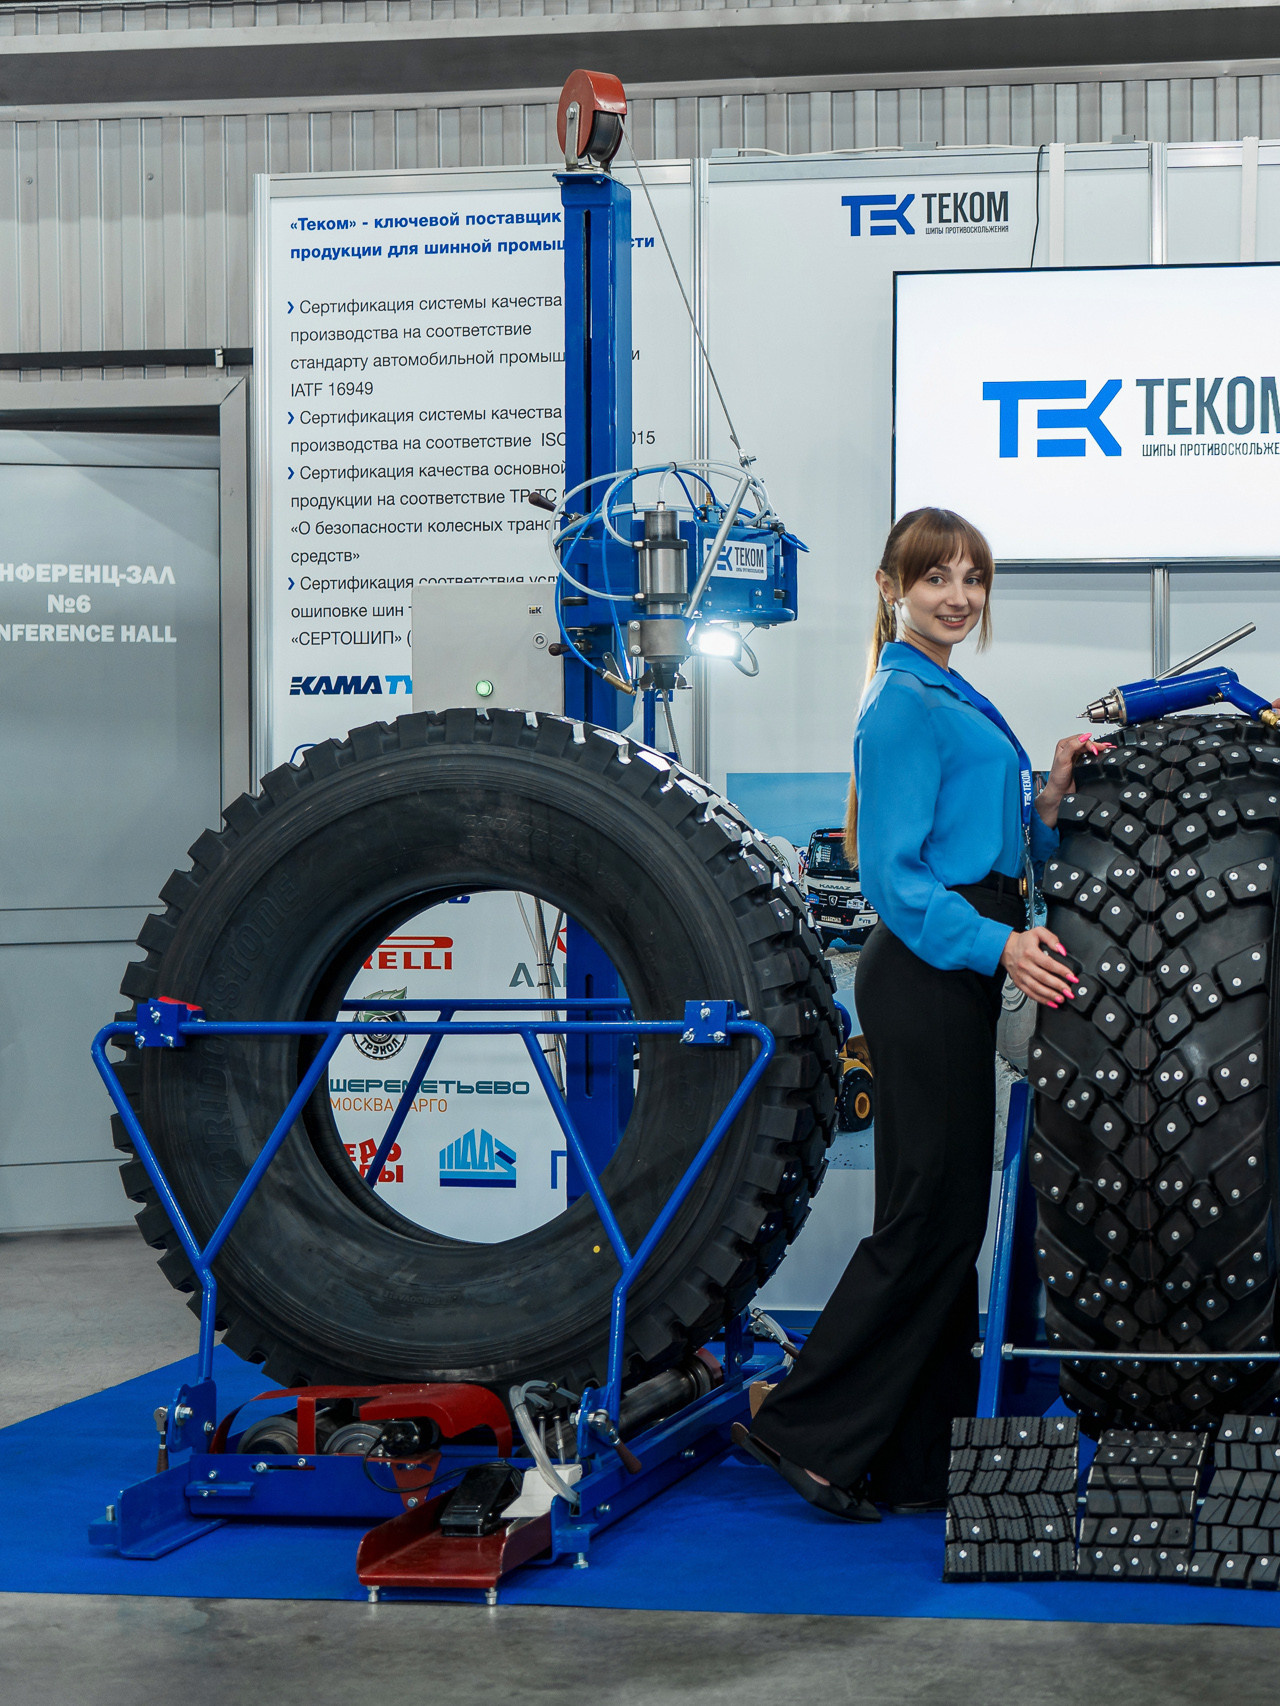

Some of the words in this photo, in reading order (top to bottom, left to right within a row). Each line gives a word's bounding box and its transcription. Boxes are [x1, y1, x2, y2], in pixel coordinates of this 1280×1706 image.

[921, 190, 1009, 224] ТЕКОМ
[290, 217, 357, 232] «Теком»
[374, 211, 460, 229] ключевой
[465, 212, 562, 226] поставщик
[925, 226, 944, 235] ШИПЫ
[945, 225, 1009, 235] ПРОТИВОСКОЛЬЖЕНИЯ
[290, 245, 383, 262] продукции
[387, 244, 419, 259] для
[424, 238, 492, 255] шинной
[299, 298, 414, 317] Сертификация
[419, 297, 487, 311] системы
[491, 295, 563, 309] качества
[290, 328, 399, 346] производства
[403, 327, 422, 339] на
[425, 324, 532, 338] соответствие
[290, 356, 369, 372] стандарту
[372, 349, 495, 368] автомобильной
[291, 382, 324, 398] IATF
[328, 381, 374, 397] 16949
[290, 439, 399, 456] производства
[403, 438, 422, 450] на
[425, 436, 532, 450] соответствие
[1141, 443, 1177, 457] ШИПЫ
[299, 464, 414, 483] Сертификация
[419, 465, 490, 478] качества
[291, 495, 373, 511] продукции
[377, 494, 396, 506] на
[399, 492, 506, 506] соответствие
[290, 551, 360, 567] средств»
[734, 546, 765, 568] ТЕКОМ
[300, 575, 414, 594] Сертификация
[47, 594, 92, 613] №6
[291, 606, 368, 619] ошиповке
[372, 605, 404, 617] шин
[120, 624, 178, 643] HALL
[291, 630, 402, 646] «СЕРТОШИП»
[198, 870, 300, 1184] BRIDGSTONE
